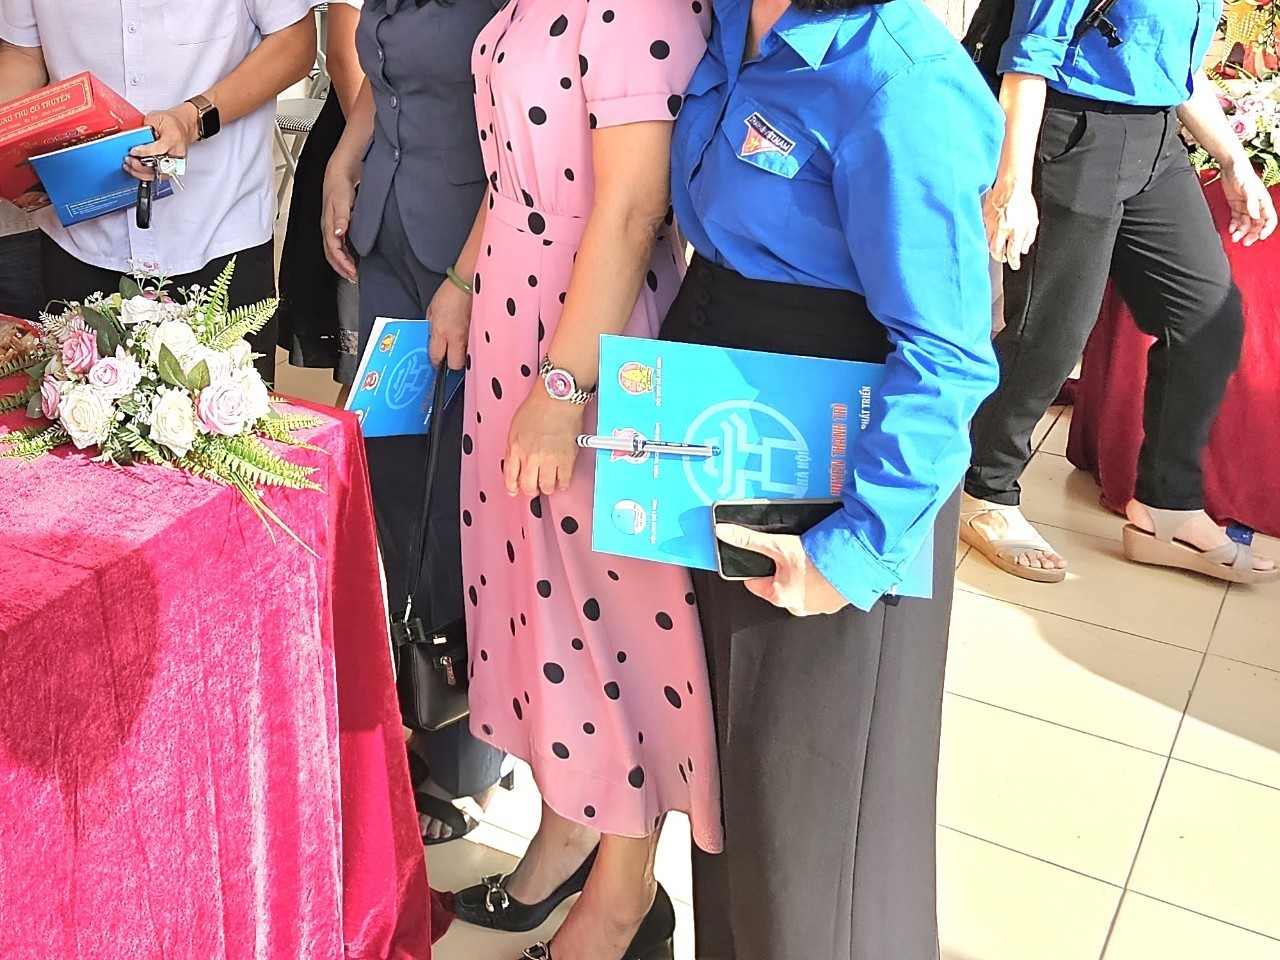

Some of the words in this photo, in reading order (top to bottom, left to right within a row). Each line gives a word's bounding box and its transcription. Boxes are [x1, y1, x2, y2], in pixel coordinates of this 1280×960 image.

[14, 109, 28, 121] THU
[859, 386, 871, 409] TRIỂN
[831, 423, 847, 457] THANH
[795, 451, 812, 469] NỘI
[795, 471, 809, 487] HÀ
